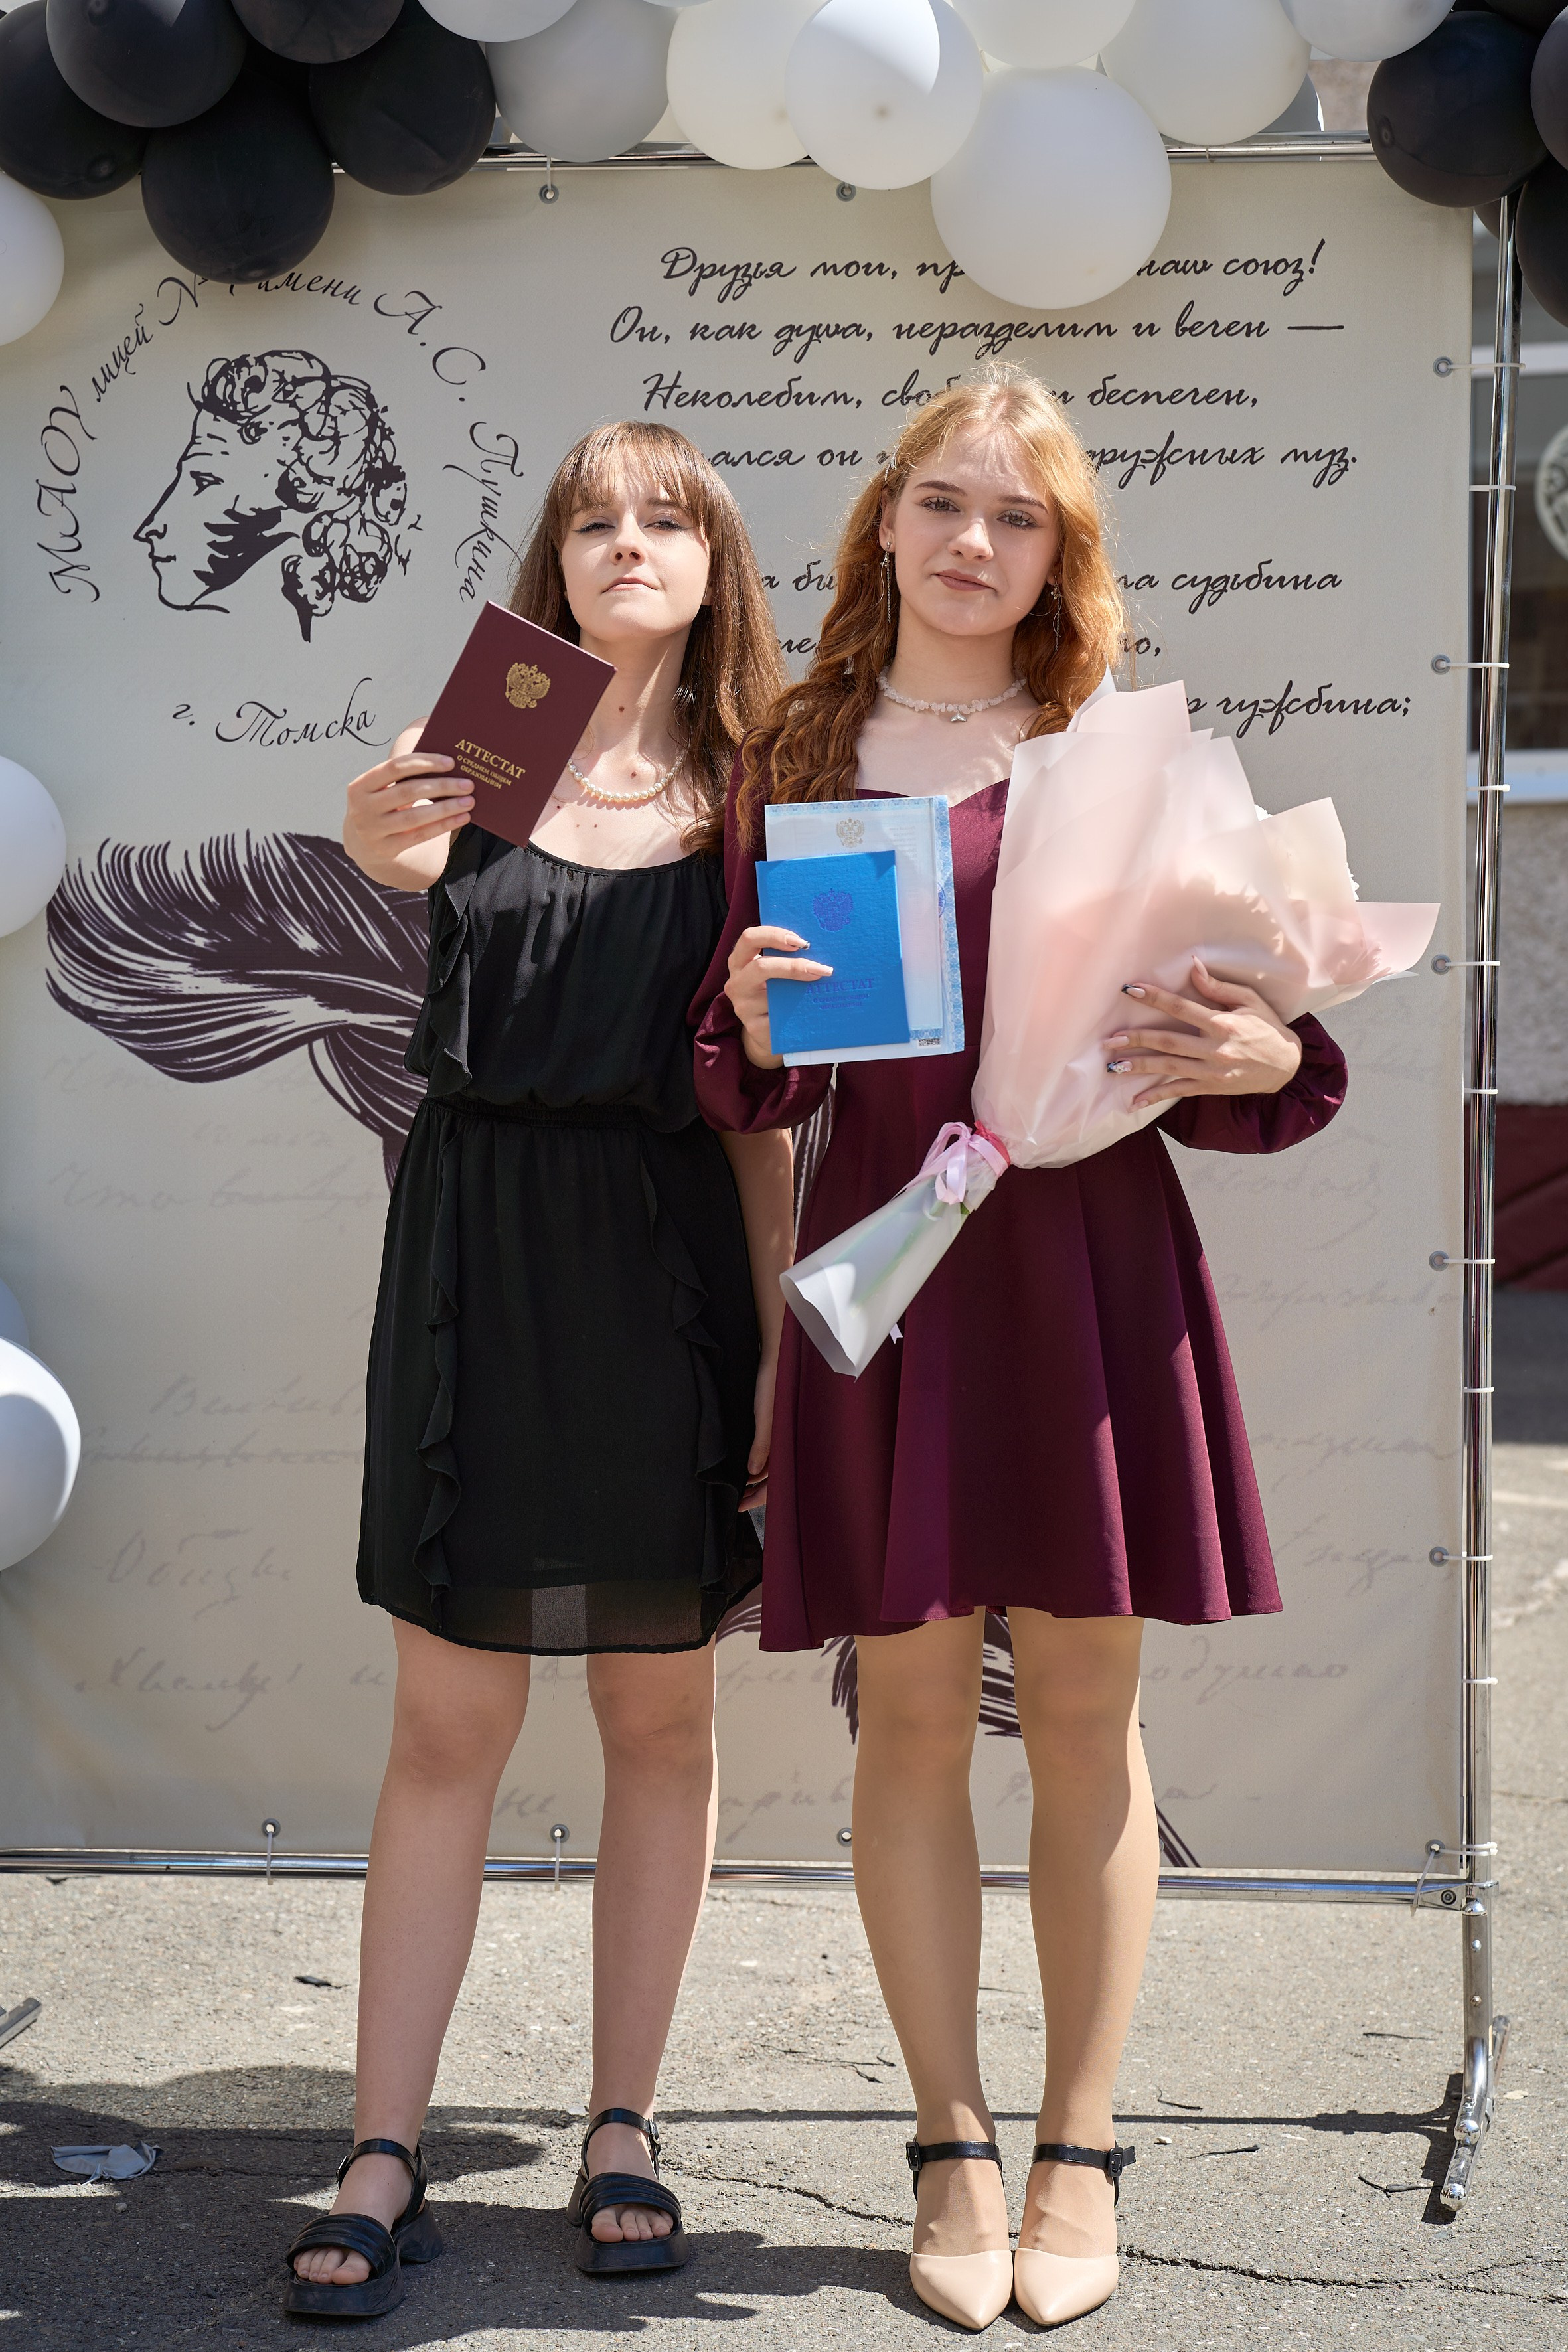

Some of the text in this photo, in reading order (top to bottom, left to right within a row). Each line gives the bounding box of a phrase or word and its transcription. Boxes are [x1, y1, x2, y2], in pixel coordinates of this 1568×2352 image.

[661, 246, 797, 303] Друзья
[810, 260, 898, 280] мои,
[1223, 238, 1326, 296] союз!
[610, 305, 670, 344] Он,
[689, 321, 763, 341] как
[772, 323, 873, 364] душа,
[892, 321, 1118, 360] неразделим
[1132, 322, 1162, 337] и
[1174, 299, 1270, 338] вечен
[643, 370, 862, 412] Неколебим,
[1087, 374, 1258, 408] беспечен,
[36, 384, 100, 603] МАОУ
[91, 303, 153, 402] лицей
[442, 421, 524, 603] Пушкина
[817, 449, 863, 467] он
[1280, 447, 1357, 489] муз.
[1171, 558, 1342, 615] судьбина
[171, 676, 392, 747] г. Томска
[1215, 680, 1411, 739] чужбина;
[455, 739, 526, 779] АТТЕСТАТ
[805, 979, 874, 994] АТТЕСТАТ
